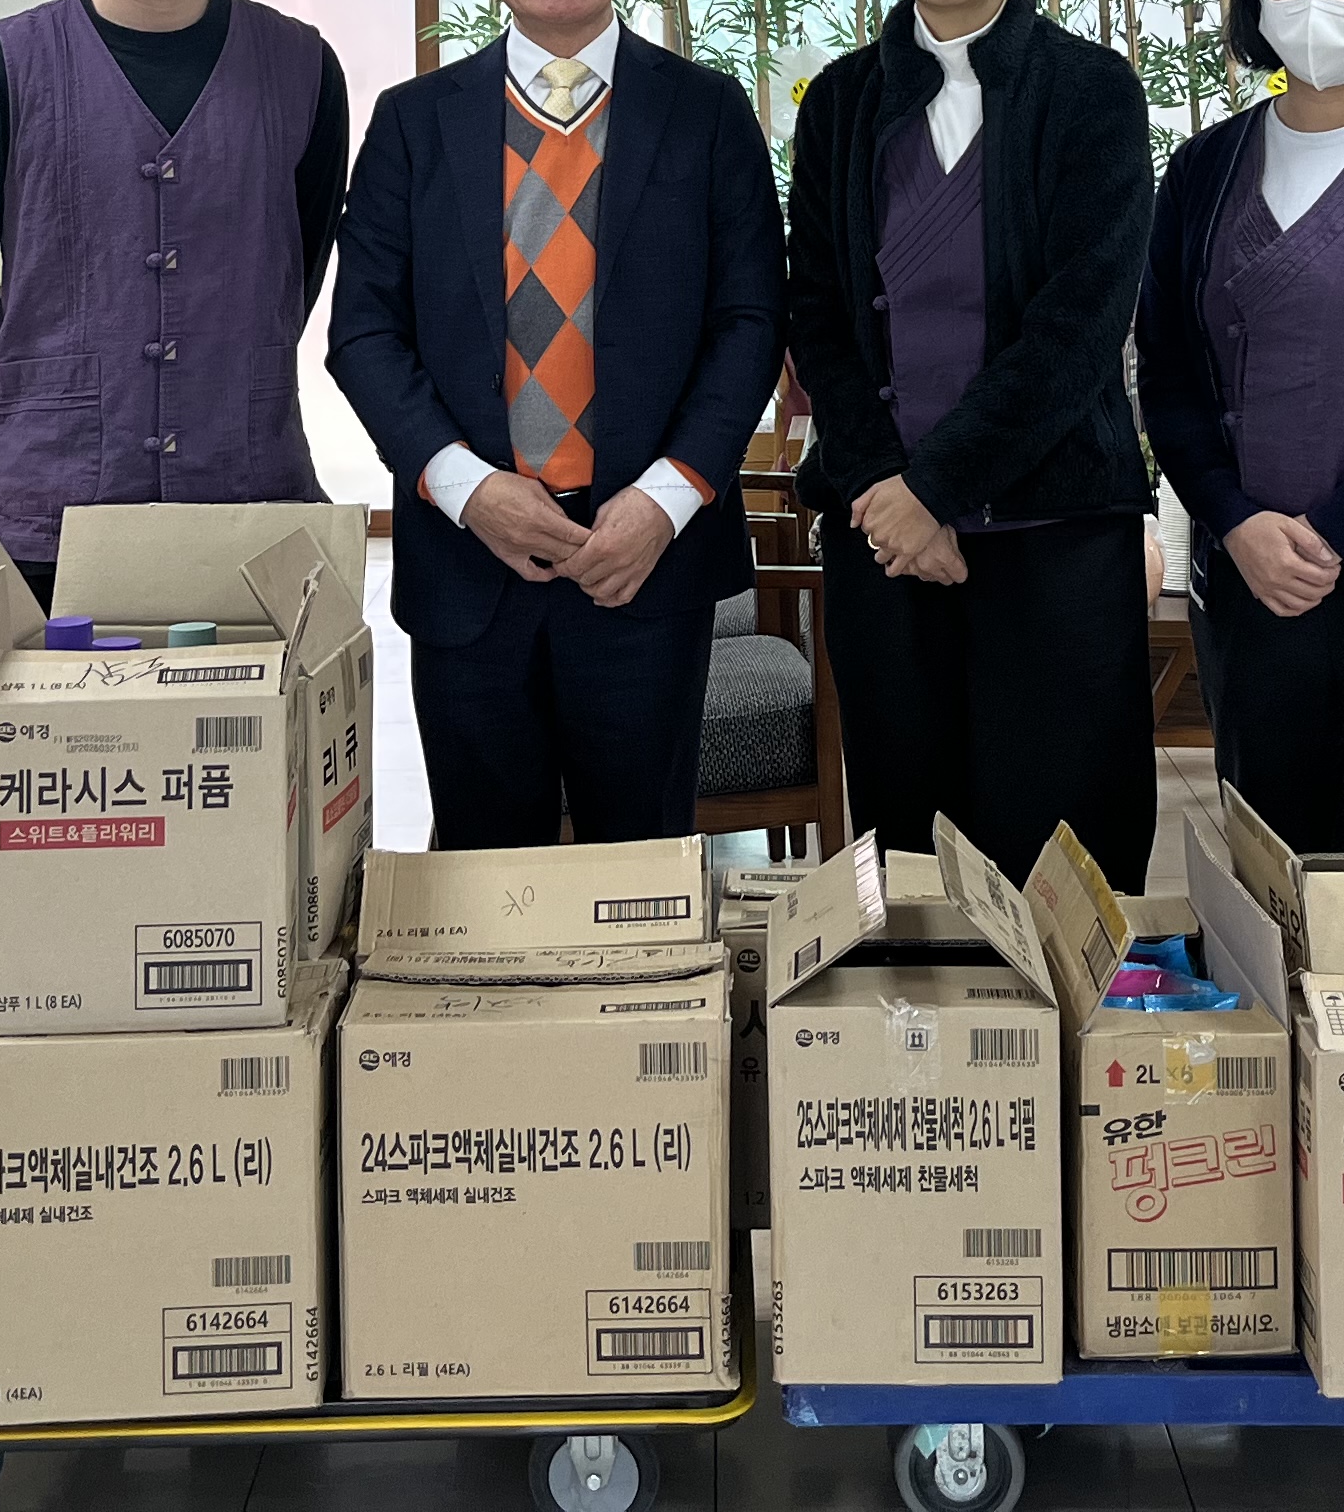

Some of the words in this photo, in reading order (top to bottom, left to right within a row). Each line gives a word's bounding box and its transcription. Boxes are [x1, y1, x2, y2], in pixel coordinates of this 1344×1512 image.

[20, 724, 50, 739] 애경
[161, 763, 234, 810] 퍼퓸
[8, 822, 156, 845] 스위트&플라워리
[307, 876, 319, 942] 6150866
[163, 928, 235, 949] 6085070
[407, 926, 430, 937] 리필
[25, 996, 30, 1010] 1
[36, 996, 42, 1010] L
[61, 993, 82, 1009] EA)
[816, 1030, 840, 1045] 애경
[383, 1051, 411, 1068] 애경
[1136, 1064, 1161, 1085] 2L
[797, 1097, 906, 1151] 25스파크액체세제
[911, 1096, 964, 1151] 찬물세척
[969, 1100, 991, 1150] 2.6
[996, 1100, 1005, 1148] L
[1009, 1097, 1035, 1151] 리필
[1103, 1110, 1167, 1146] 유한
[361, 1127, 582, 1176] 24스파크액체실내건조
[589, 1128, 624, 1172] 2.6
[632, 1128, 646, 1168] L
[654, 1123, 692, 1173] (리)
[167, 1143, 204, 1188] 2.6
[212, 1144, 226, 1184] L
[234, 1136, 273, 1188] (리)
[799, 1167, 845, 1192] 스파크
[850, 1166, 912, 1193] 액체세제
[918, 1166, 979, 1193] 찬물세척
[1109, 1124, 1277, 1222] 펑크린
[362, 1188, 402, 1205] 스파크
[406, 1187, 459, 1205] 액체세제
[464, 1186, 517, 1204] 실내건조
[40, 1205, 94, 1223] 실내건조
[937, 1282, 1019, 1301] 6153263
[1130, 1293, 1152, 1301] 188
[609, 1295, 690, 1315] 6142664
[185, 1309, 269, 1332] 6142664
[306, 1306, 319, 1383] 6142664
[365, 1364, 385, 1378] 2.6
[390, 1365, 398, 1378] L
[402, 1362, 429, 1378] 리필
[435, 1361, 472, 1377] (4EA)
[6, 1386, 43, 1402] (4EA)
